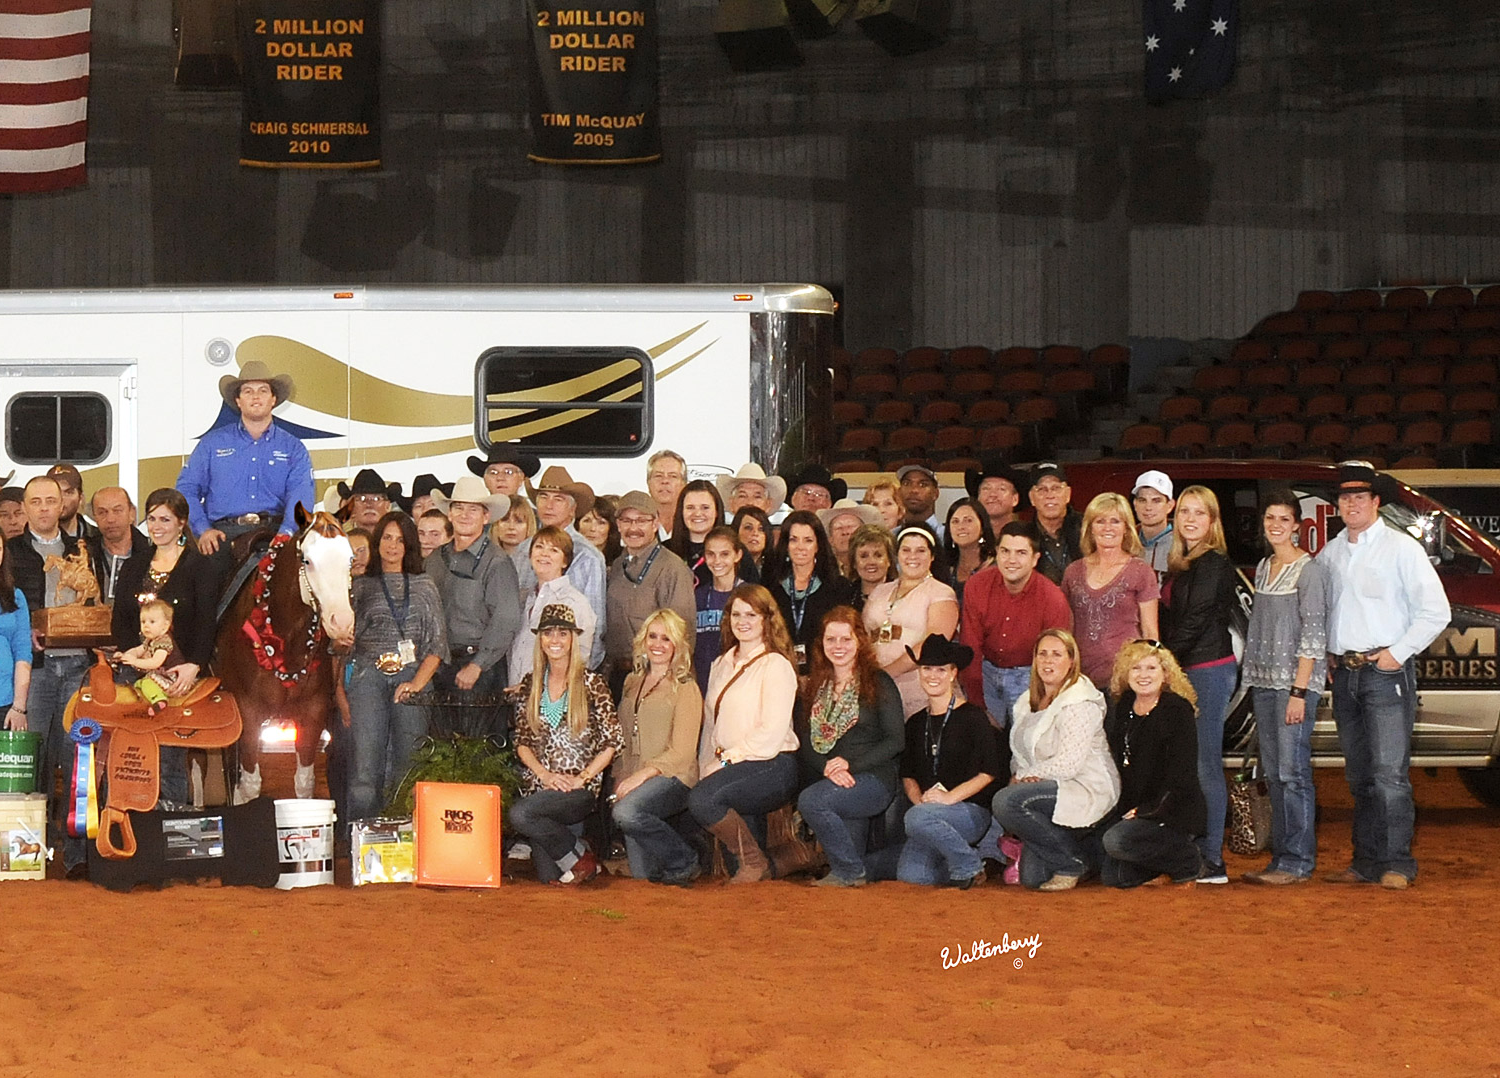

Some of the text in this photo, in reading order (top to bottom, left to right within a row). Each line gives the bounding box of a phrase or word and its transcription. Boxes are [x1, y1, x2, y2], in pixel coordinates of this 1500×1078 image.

[537, 10, 645, 27] 2 MILLION
[255, 19, 364, 35] 2 MILLION
[550, 33, 635, 49] DOLLAR
[266, 42, 353, 58] DOLLAR
[560, 56, 626, 72] RIDER
[276, 65, 343, 80] RIDER
[250, 122, 370, 135] CRAIG SCHMERSAL
[541, 112, 646, 129] TIM McQUAY
[288, 140, 331, 154] 2010
[573, 132, 615, 147] 2005
